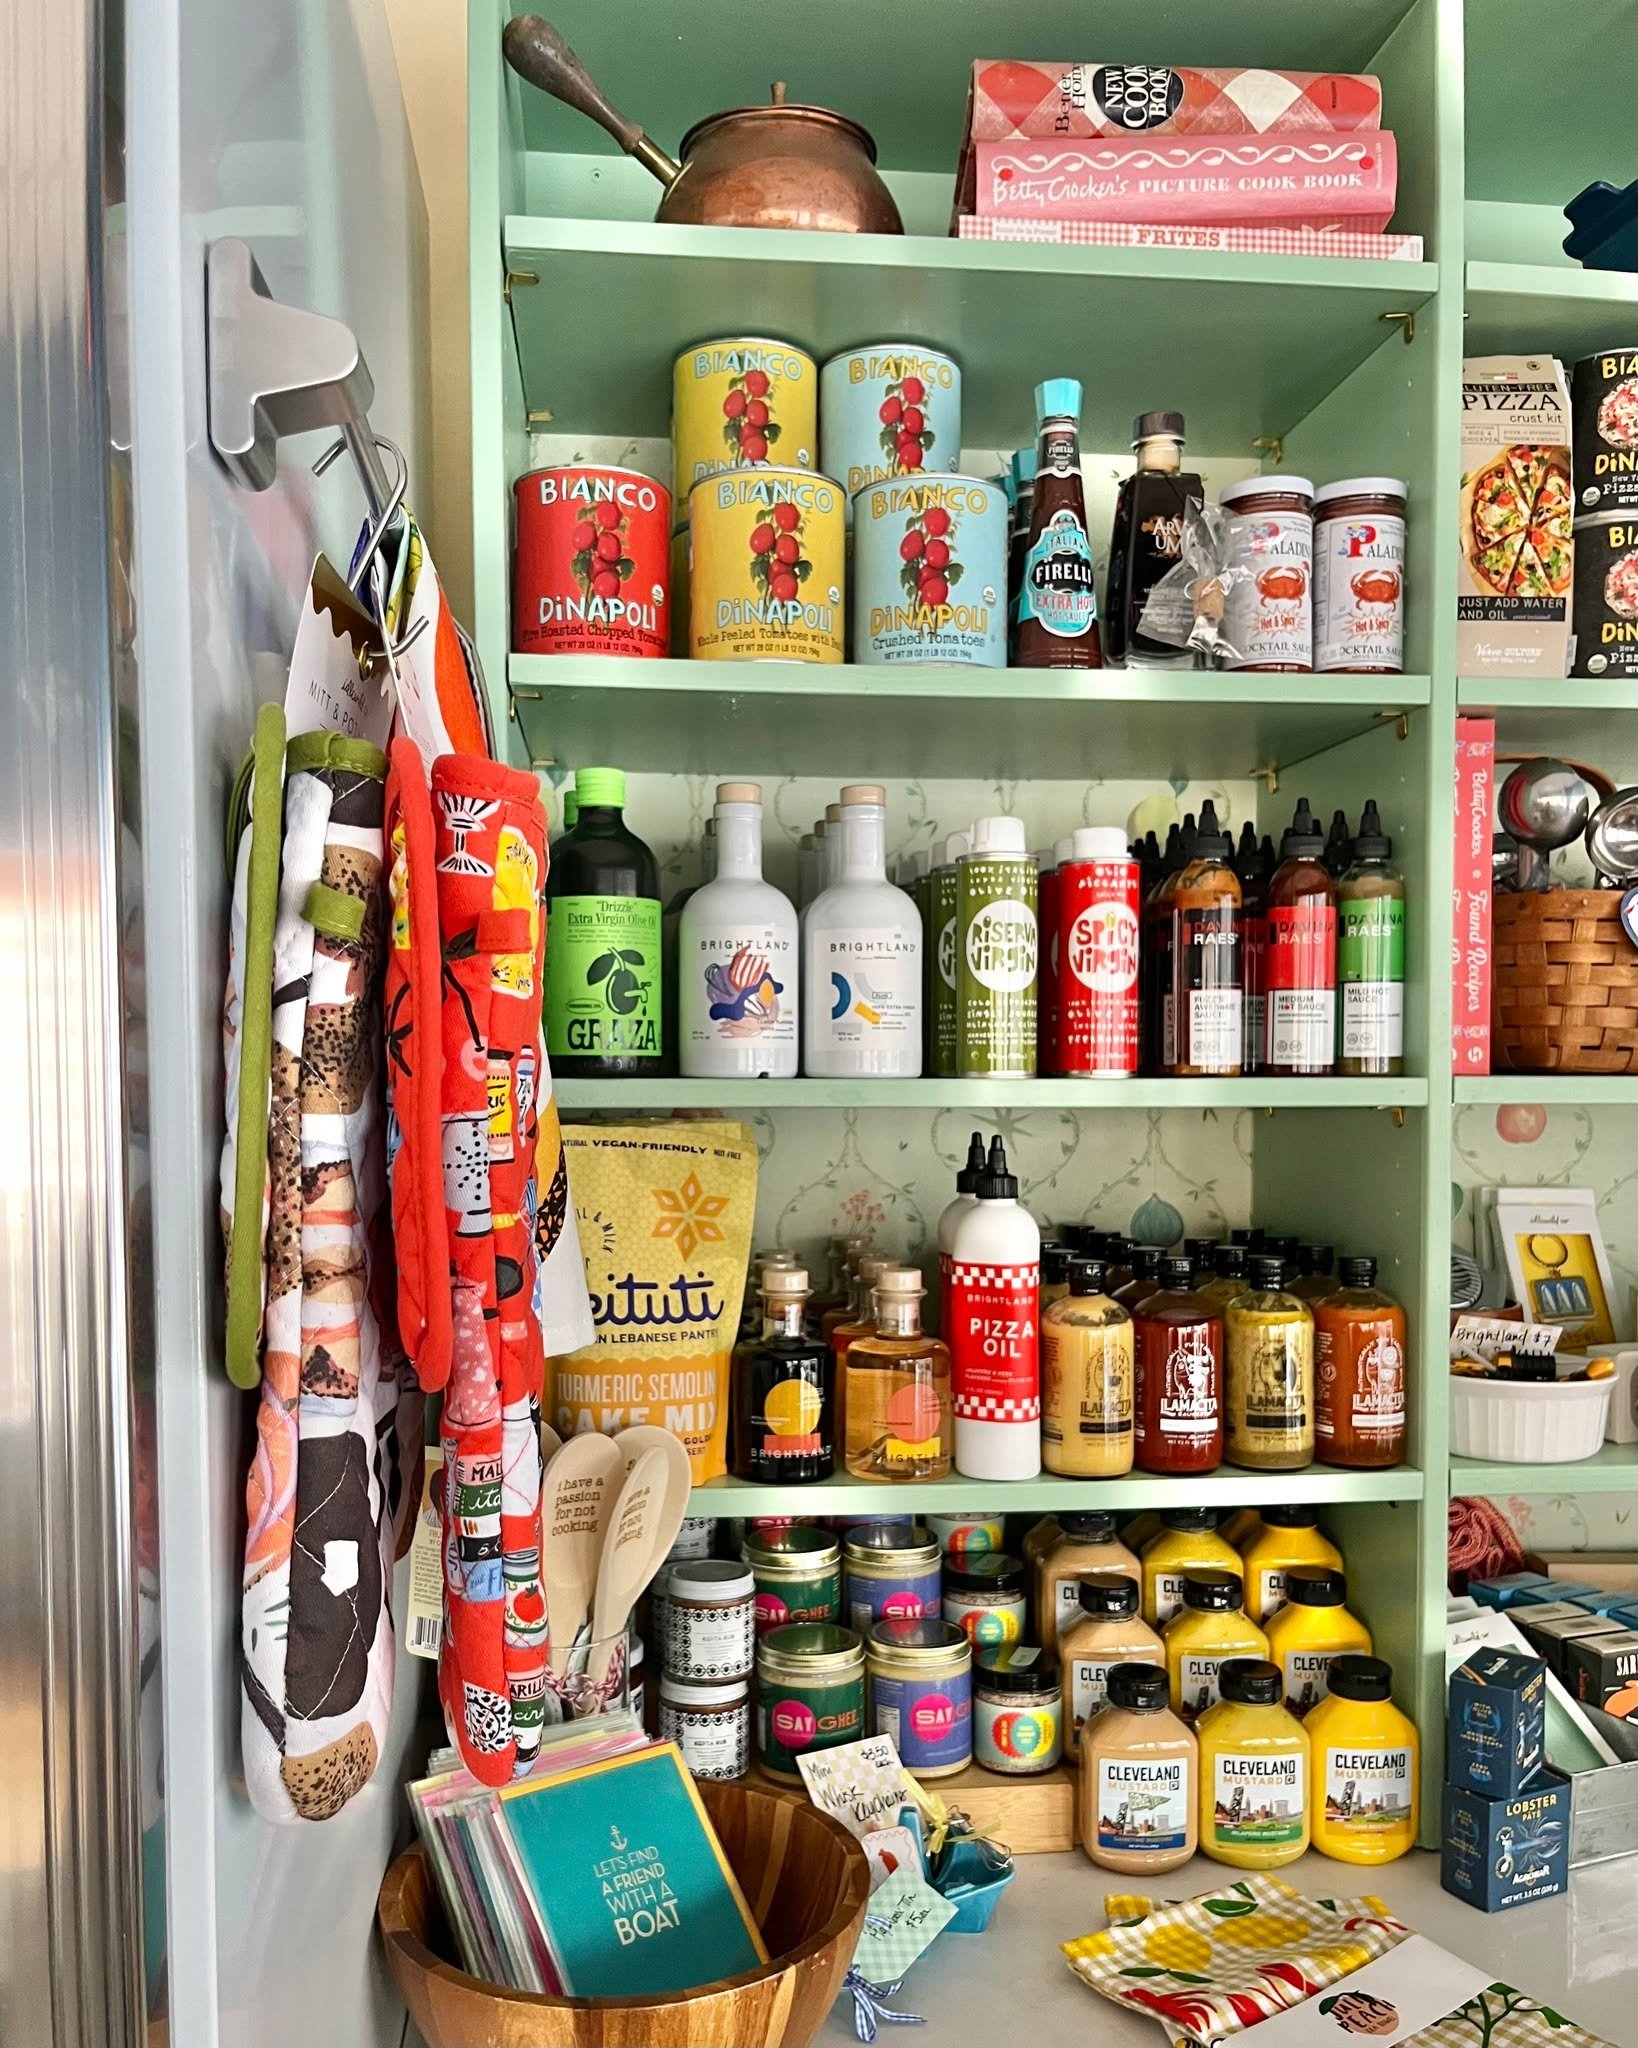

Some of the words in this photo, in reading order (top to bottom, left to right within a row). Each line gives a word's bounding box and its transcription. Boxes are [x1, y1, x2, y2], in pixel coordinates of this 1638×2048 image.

[1105, 68, 1124, 109] NEW
[1123, 65, 1149, 128] COOK
[1149, 66, 1168, 118] BOOK
[1055, 73, 1071, 132] Better
[992, 175, 1044, 208] Betty
[1047, 174, 1130, 202] Crocker's
[1138, 177, 1229, 193] PICTURE
[1238, 175, 1296, 192] COOK
[1303, 173, 1364, 190] BOOK
[1136, 228, 1221, 248] FRITES
[694, 349, 803, 381] BIANCO
[849, 354, 953, 389] BIANCO
[1462, 383, 1555, 392] LUTEN-FREE
[1462, 393, 1562, 411] PIZZA
[1509, 414, 1541, 423] crust
[1546, 413, 1562, 423] kit
[540, 477, 657, 513] BIANCO
[718, 480, 833, 515] BIANCO
[872, 484, 988, 518] BIANCO
[1036, 595, 1072, 609] EXTRA
[1459, 598, 1490, 607] JUST
[1494, 598, 1519, 608] ADD
[1523, 598, 1563, 608] WATER
[539, 596, 656, 631] DiNAPOLI
[717, 599, 832, 633] DiNAPOLI
[870, 602, 988, 637] DiNAPOLI
[1047, 611, 1063, 621] HOT
[1065, 611, 1087, 622] SAUCE
[1260, 616, 1272, 629] Hot
[1459, 609, 1484, 620] AND
[1488, 609, 1507, 620] OIL
[541, 624, 583, 639] Roasted
[587, 624, 635, 641] Chopped
[1355, 619, 1367, 631] Hot
[721, 628, 755, 642] Peeled
[759, 628, 809, 642] Tomatoes
[873, 634, 922, 651] Crushed
[928, 631, 986, 648] Tomatoes
[308, 680, 331, 711] MITT
[332, 702, 339, 720] &
[568, 912, 593, 924] Extra
[596, 913, 625, 927] Virgin
[628, 914, 647, 925] Olive
[1469, 889, 1488, 945] Found
[1194, 932, 1237, 945] RAES
[1278, 932, 1322, 944] RAES
[1347, 924, 1392, 937] RAES
[701, 940, 789, 951] BRIGHTLAND
[830, 942, 915, 953] BRIGHTLAND
[1467, 943, 1488, 1012] Recipes
[1347, 995, 1376, 1003] SAUCE
[567, 1018, 657, 1050] GRAZA
[562, 1139, 588, 1147] ATURAL
[592, 1139, 708, 1154] VEGAN-FRIENDLY
[966, 1293, 1034, 1306] BRIGHTLAND
[969, 1317, 1034, 1339] PIZZA
[1456, 1326, 1528, 1345] Brightland
[1533, 1330, 1553, 1348] $7
[611, 1332, 677, 1344] LEBANESE
[983, 1338, 1022, 1357] OIL
[557, 1373, 643, 1403] TURMERIC
[1160, 1397, 1218, 1416] LLAMACITA
[751, 1446, 832, 1459] BRIGHTLAND
[564, 1478, 593, 1491] have
[595, 1477, 604, 1486] a
[555, 1491, 601, 1509] passion
[555, 1507, 572, 1521] for
[573, 1505, 596, 1518] not
[552, 1519, 600, 1537] cooking
[755, 1605, 787, 1621] SAY
[790, 1604, 831, 1621] GHEE
[886, 1605, 922, 1618] SAY
[1521, 1673, 1543, 1701] LOBSTER
[776, 1716, 813, 1732] SAY
[816, 1711, 857, 1731] GHEE
[916, 1707, 954, 1725] SAY
[1223, 1759, 1296, 1776] CLEVELAND
[1335, 1753, 1406, 1769] CLEVELAND
[806, 1762, 833, 1781] Mini
[1108, 1765, 1180, 1781] CLEVELAND
[1223, 1775, 1284, 1785] MUSTARD
[1335, 1769, 1395, 1780] MUSTARD
[1108, 1780, 1168, 1792] MUSTARD
[819, 1785, 864, 1810] Whisk
[1506, 1793, 1558, 1817] LOBSTER
[627, 1846, 659, 1867] FIND
[602, 1880, 614, 1896] A
[613, 1862, 665, 1892] FRIEND
[606, 1883, 657, 1915] WITH
[661, 1880, 675, 1900] A
[614, 1898, 681, 1946] BOAT
[1337, 1999, 1397, 2033] PEACH
